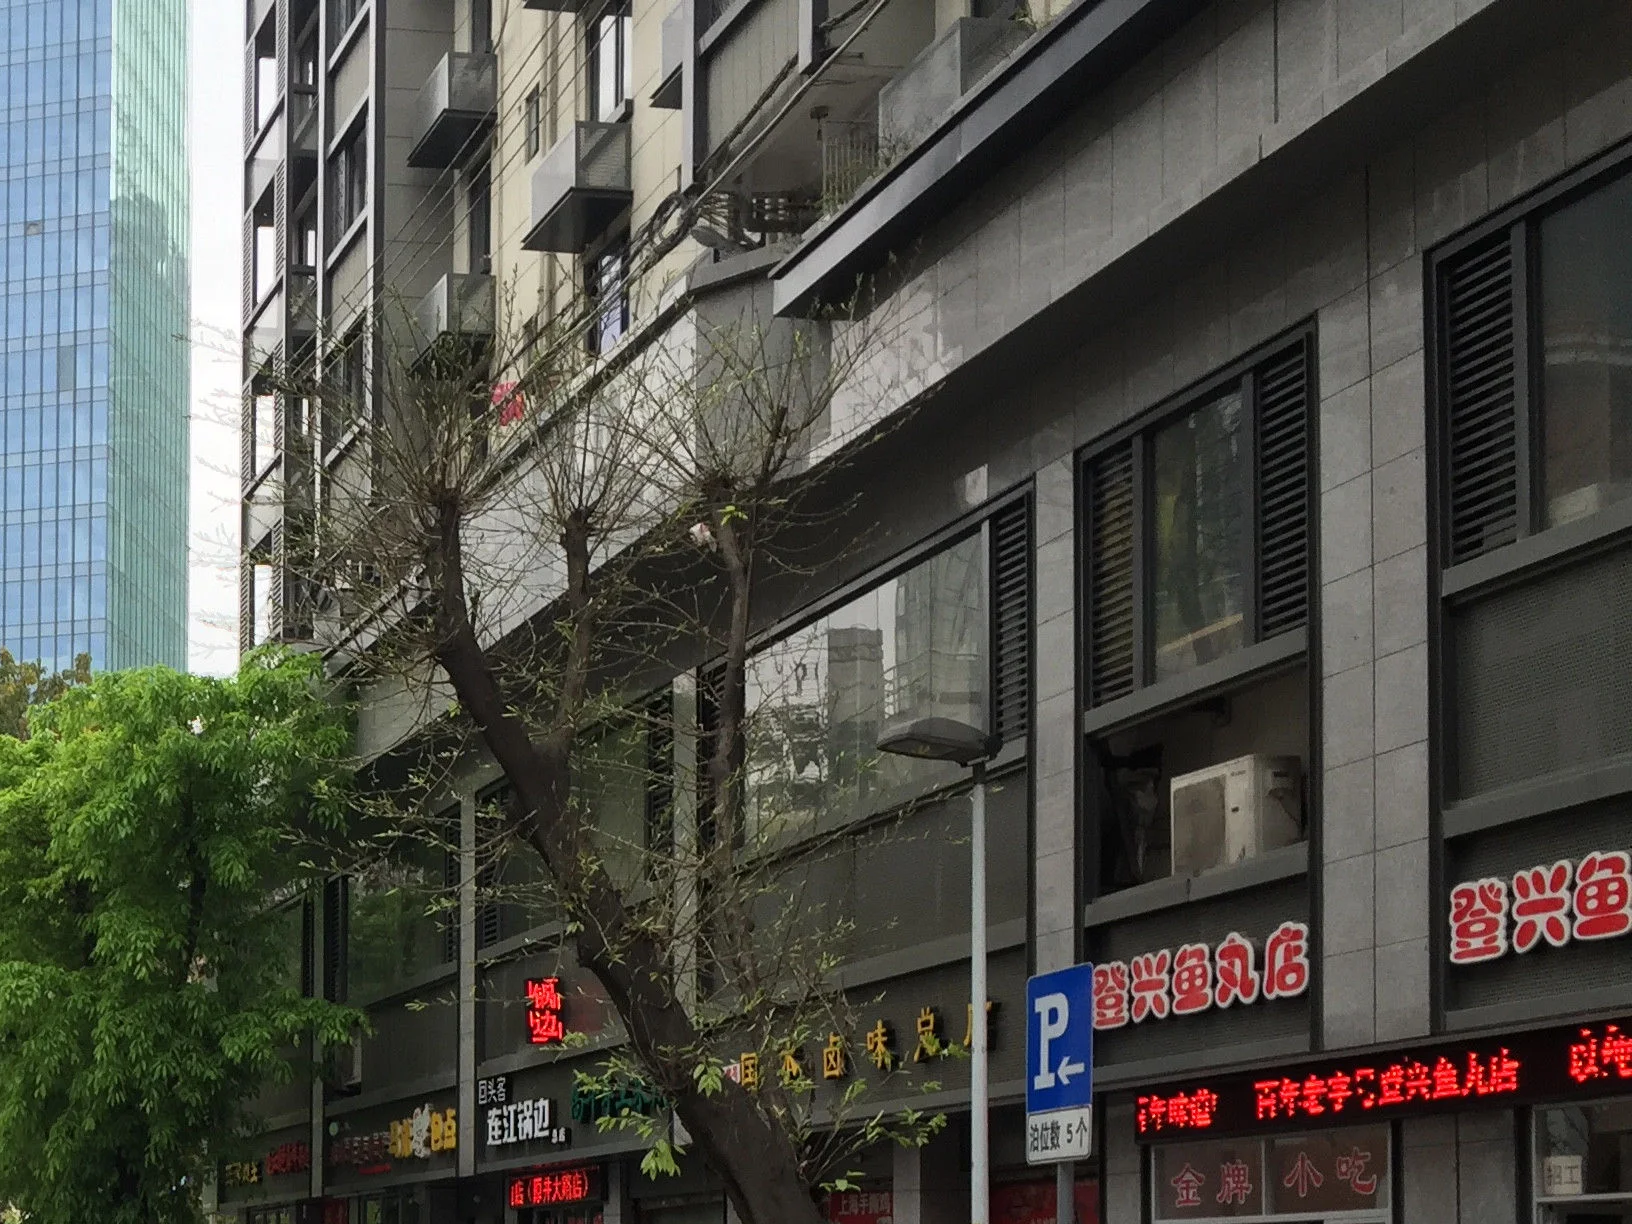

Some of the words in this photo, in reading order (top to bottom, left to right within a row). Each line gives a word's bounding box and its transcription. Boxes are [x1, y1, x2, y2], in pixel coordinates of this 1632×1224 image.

[1449, 851, 1632, 964] 登兴鱼
[1093, 921, 1309, 1029] 登兴鱼丸店
[1034, 992, 1069, 1090] P
[478, 1076, 506, 1105] 回头客
[486, 1098, 550, 1145] 连江锅边
[1029, 1120, 1061, 1152] 泊位数
[1066, 1117, 1088, 1149] 5个
[1171, 1146, 1377, 1208] 金牌小吃
